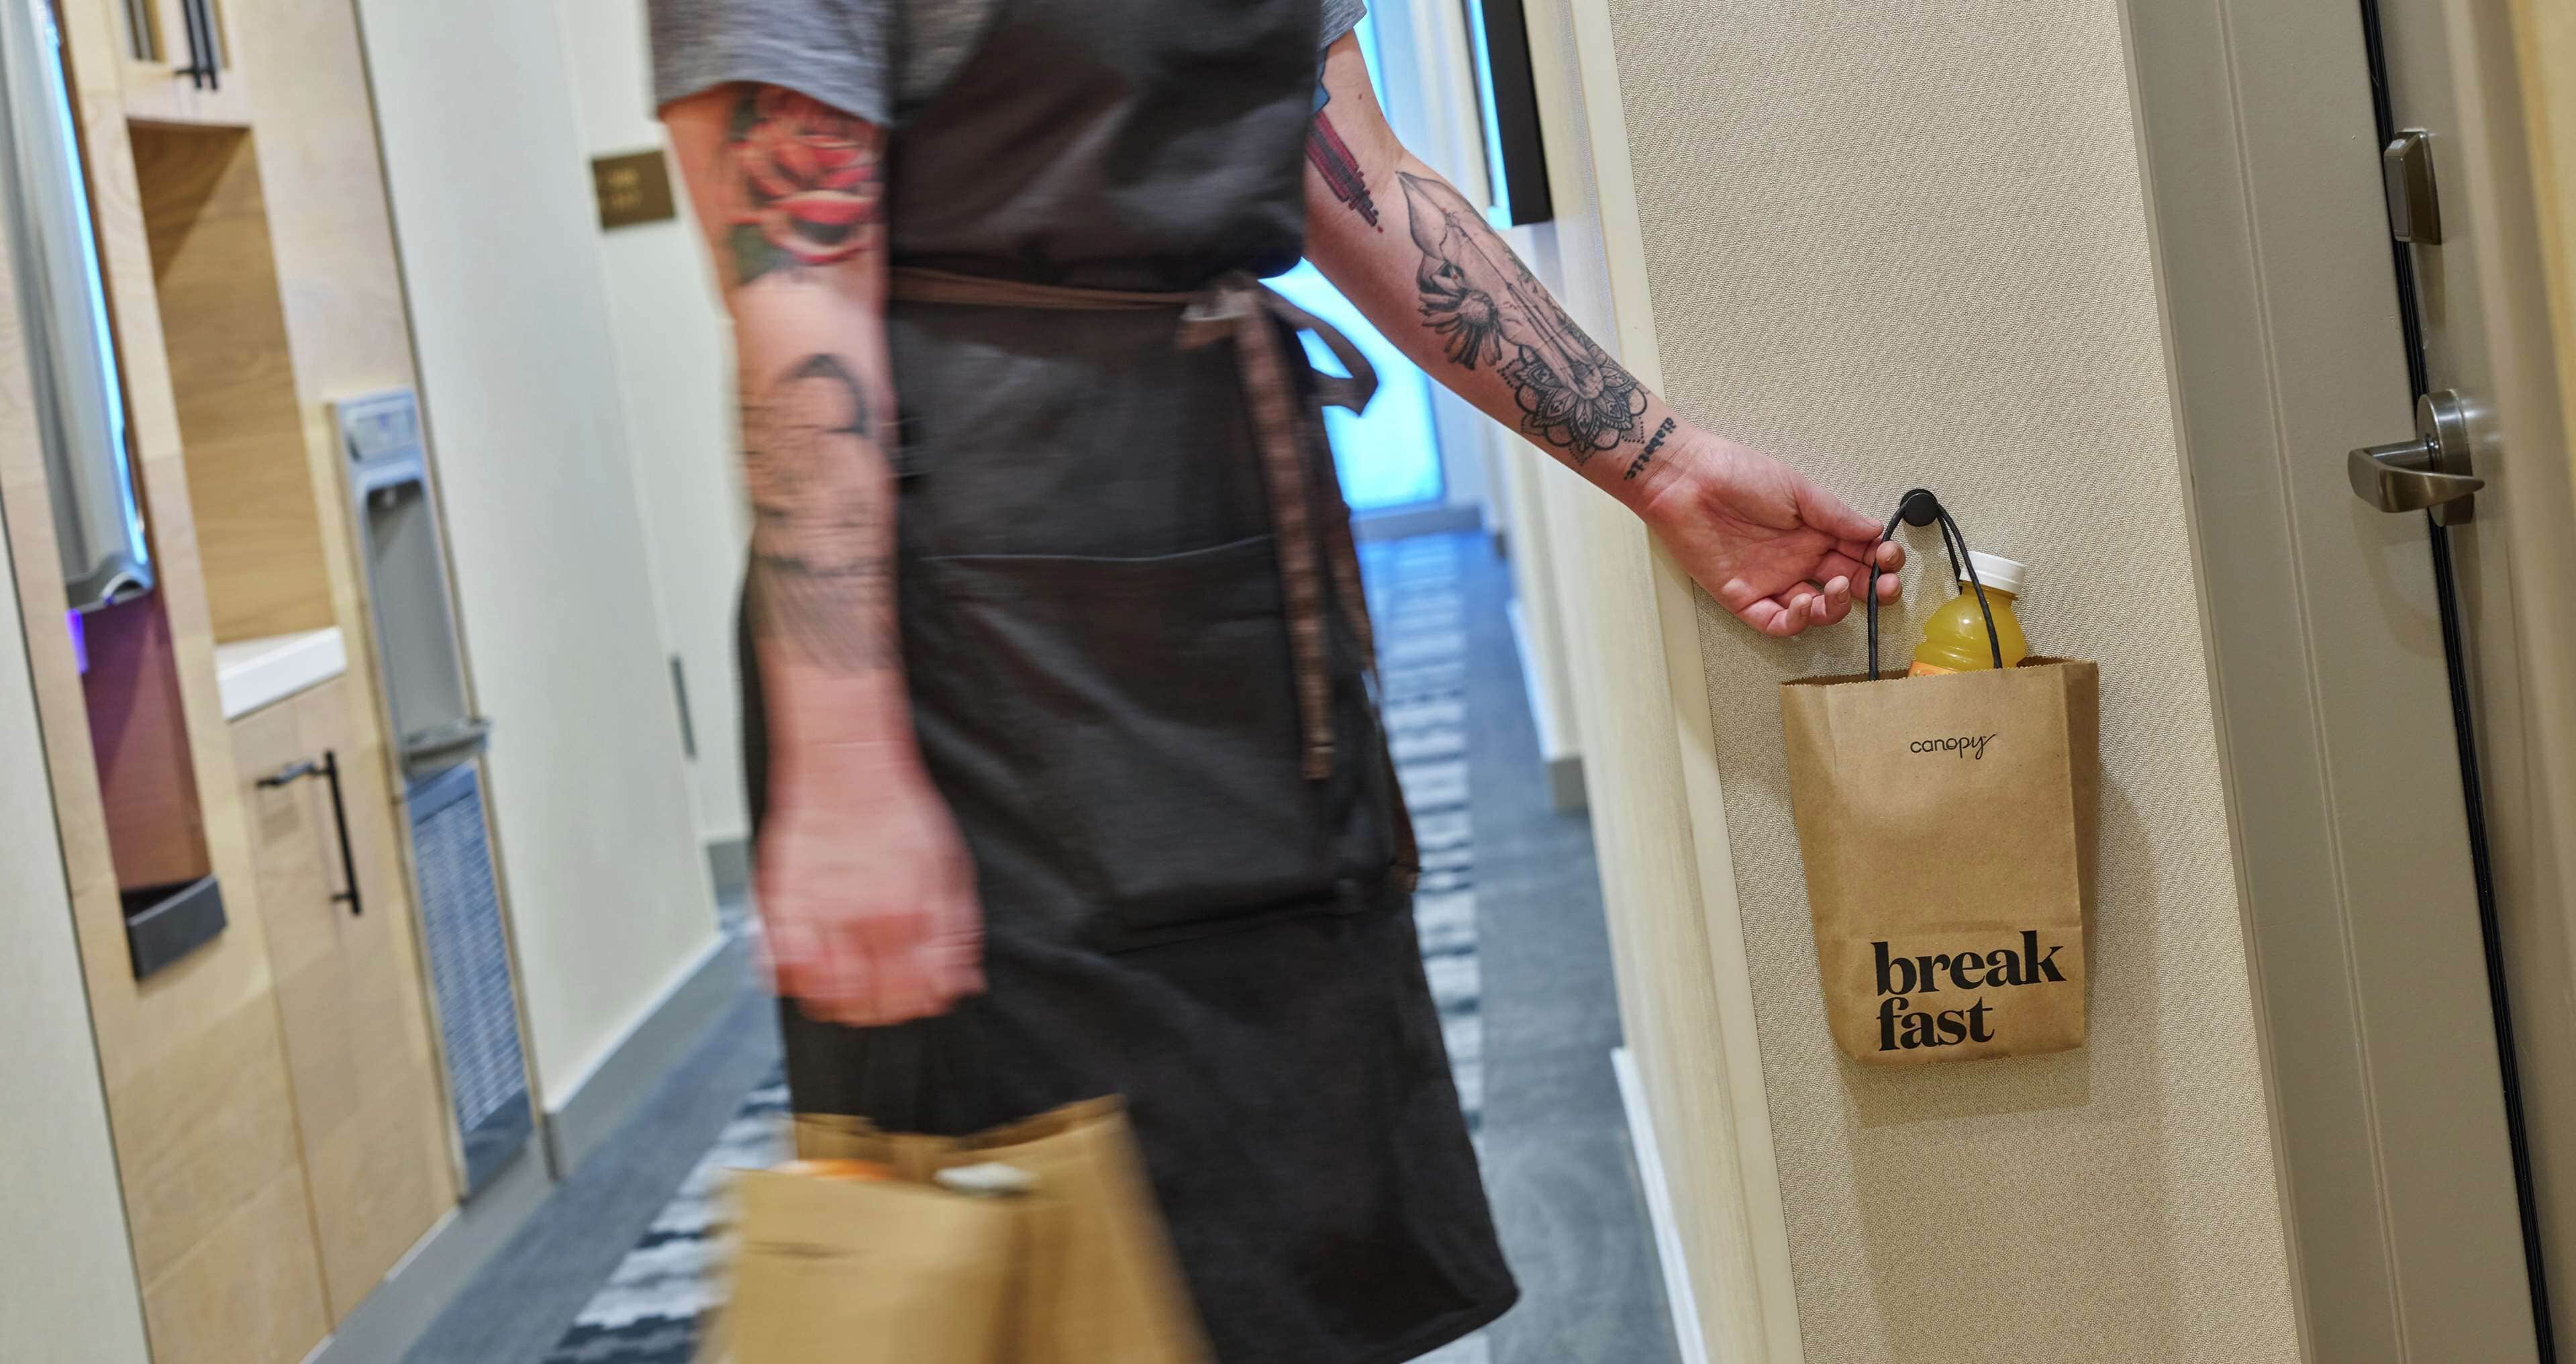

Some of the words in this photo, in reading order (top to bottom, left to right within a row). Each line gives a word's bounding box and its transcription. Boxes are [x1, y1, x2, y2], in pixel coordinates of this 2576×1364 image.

[1910, 734, 1996, 760] canopy
[1871, 930, 2067, 996] break
[1876, 996, 1995, 1052] fast
